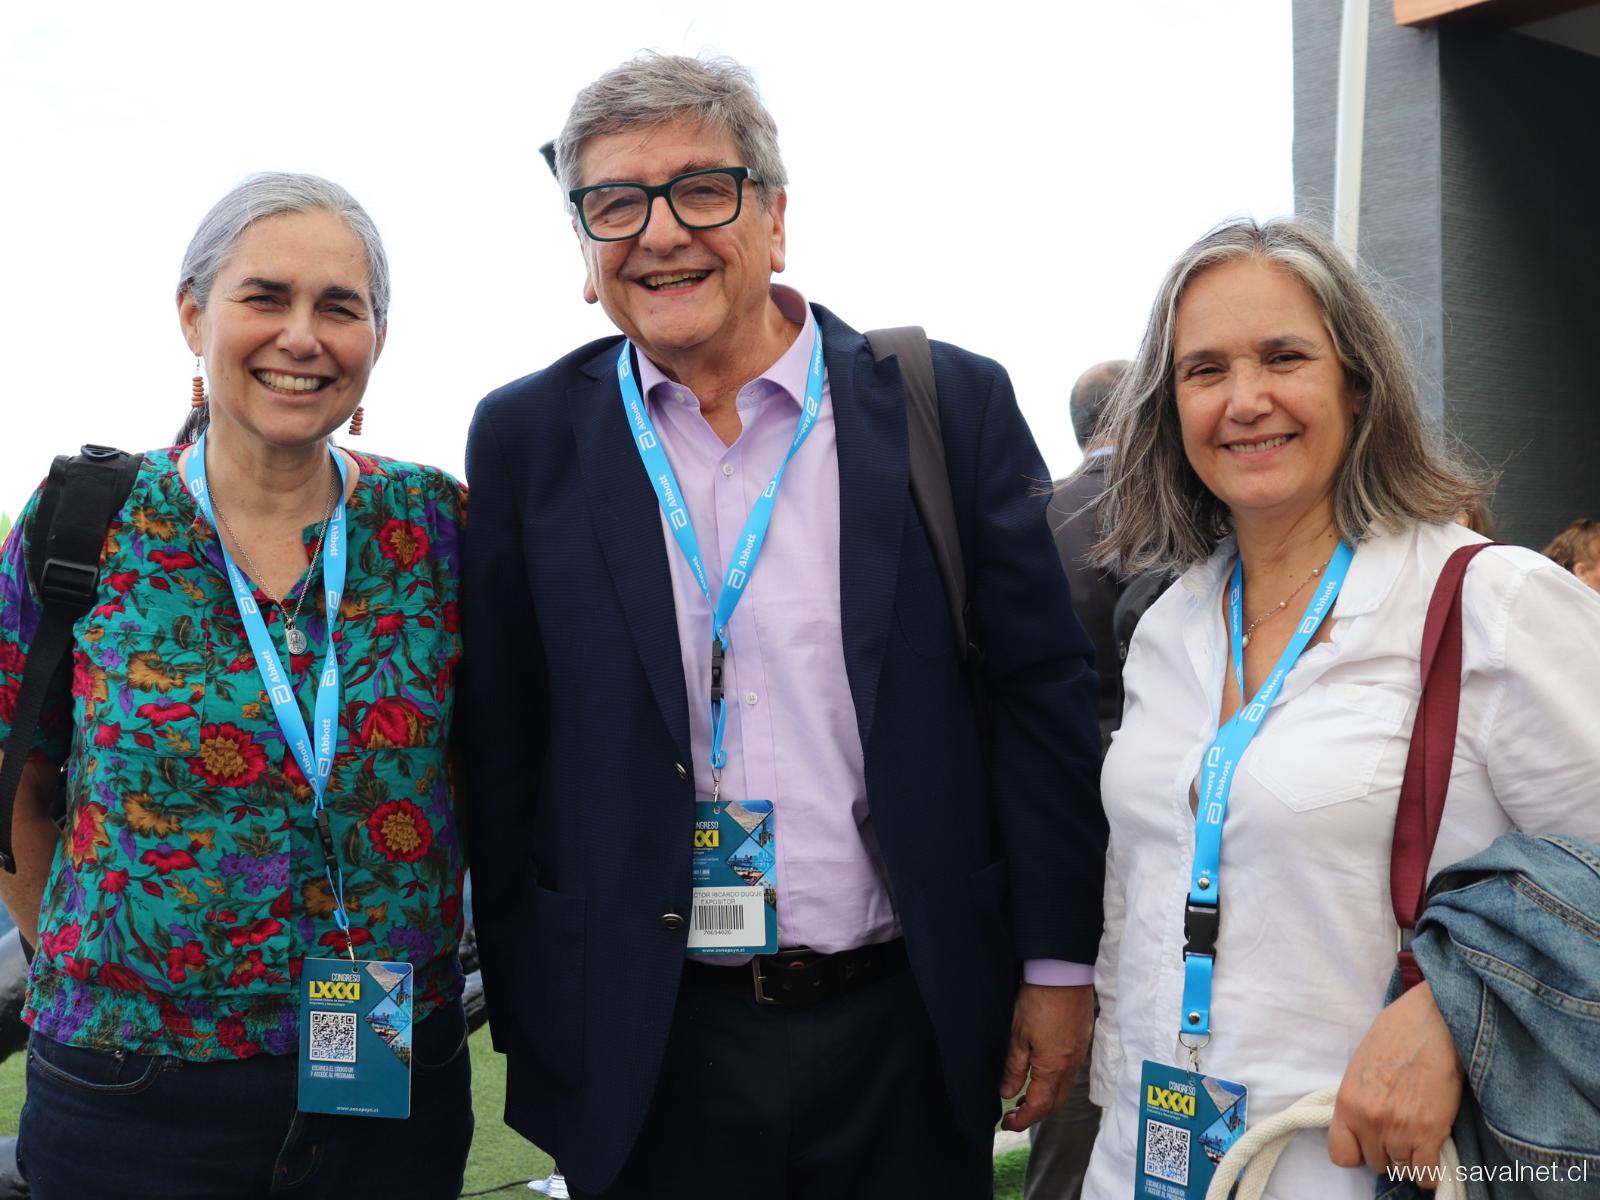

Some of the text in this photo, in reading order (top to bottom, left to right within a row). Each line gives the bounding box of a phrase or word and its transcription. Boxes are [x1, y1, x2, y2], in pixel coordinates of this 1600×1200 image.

[631, 401, 646, 430] Abbott
[658, 474, 678, 507] Abbott
[330, 525, 339, 557] Abbott
[738, 534, 757, 568] Abbott
[1313, 581, 1337, 614] Abbott
[262, 649, 281, 683] Abbott
[1260, 669, 1284, 702] Abbott
[321, 719, 331, 753] Abbott
[296, 740, 313, 775] Abbott
[1215, 760, 1232, 800] Abbott
[696, 821, 719, 829] NGRESO
[741, 890, 763, 898] DUQUE
[309, 980, 360, 1000] LXXXI
[331, 973, 360, 982] CONGRESO
[1147, 1085, 1196, 1116] LXXXI
[1168, 1081, 1196, 1096] CONGRESO
